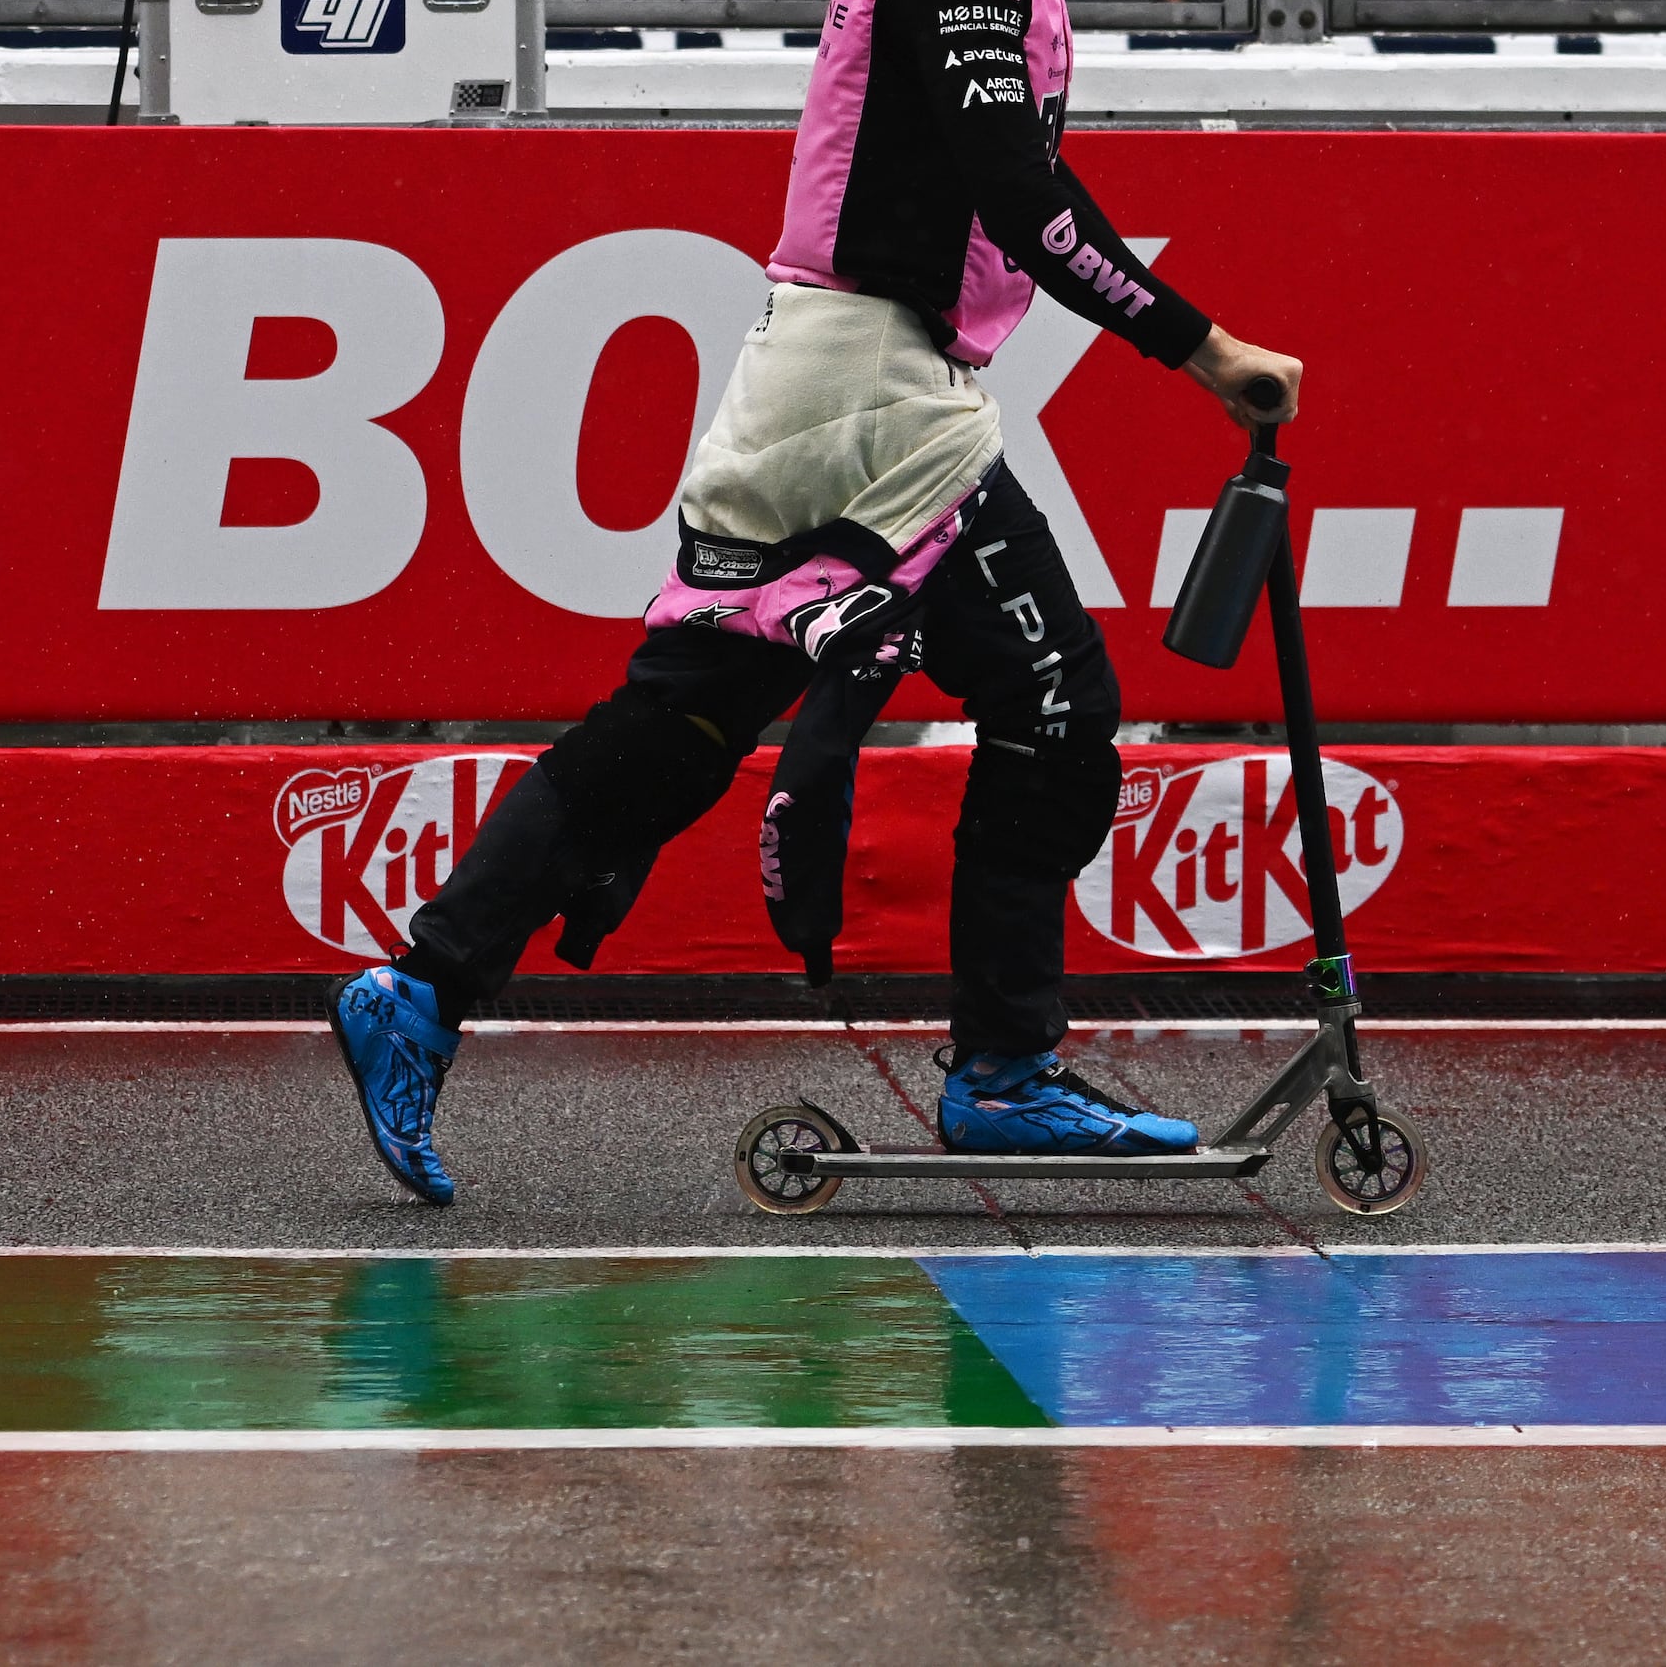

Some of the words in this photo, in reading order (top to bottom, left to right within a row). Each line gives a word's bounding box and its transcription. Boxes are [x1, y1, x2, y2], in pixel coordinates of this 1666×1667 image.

[939, 22, 988, 35] FINANCIAL
[963, 47, 1024, 65] avature
[986, 77, 1026, 91] ARCTIC
[994, 90, 1026, 103] WOLF
[1066, 242, 1155, 319] BWT
